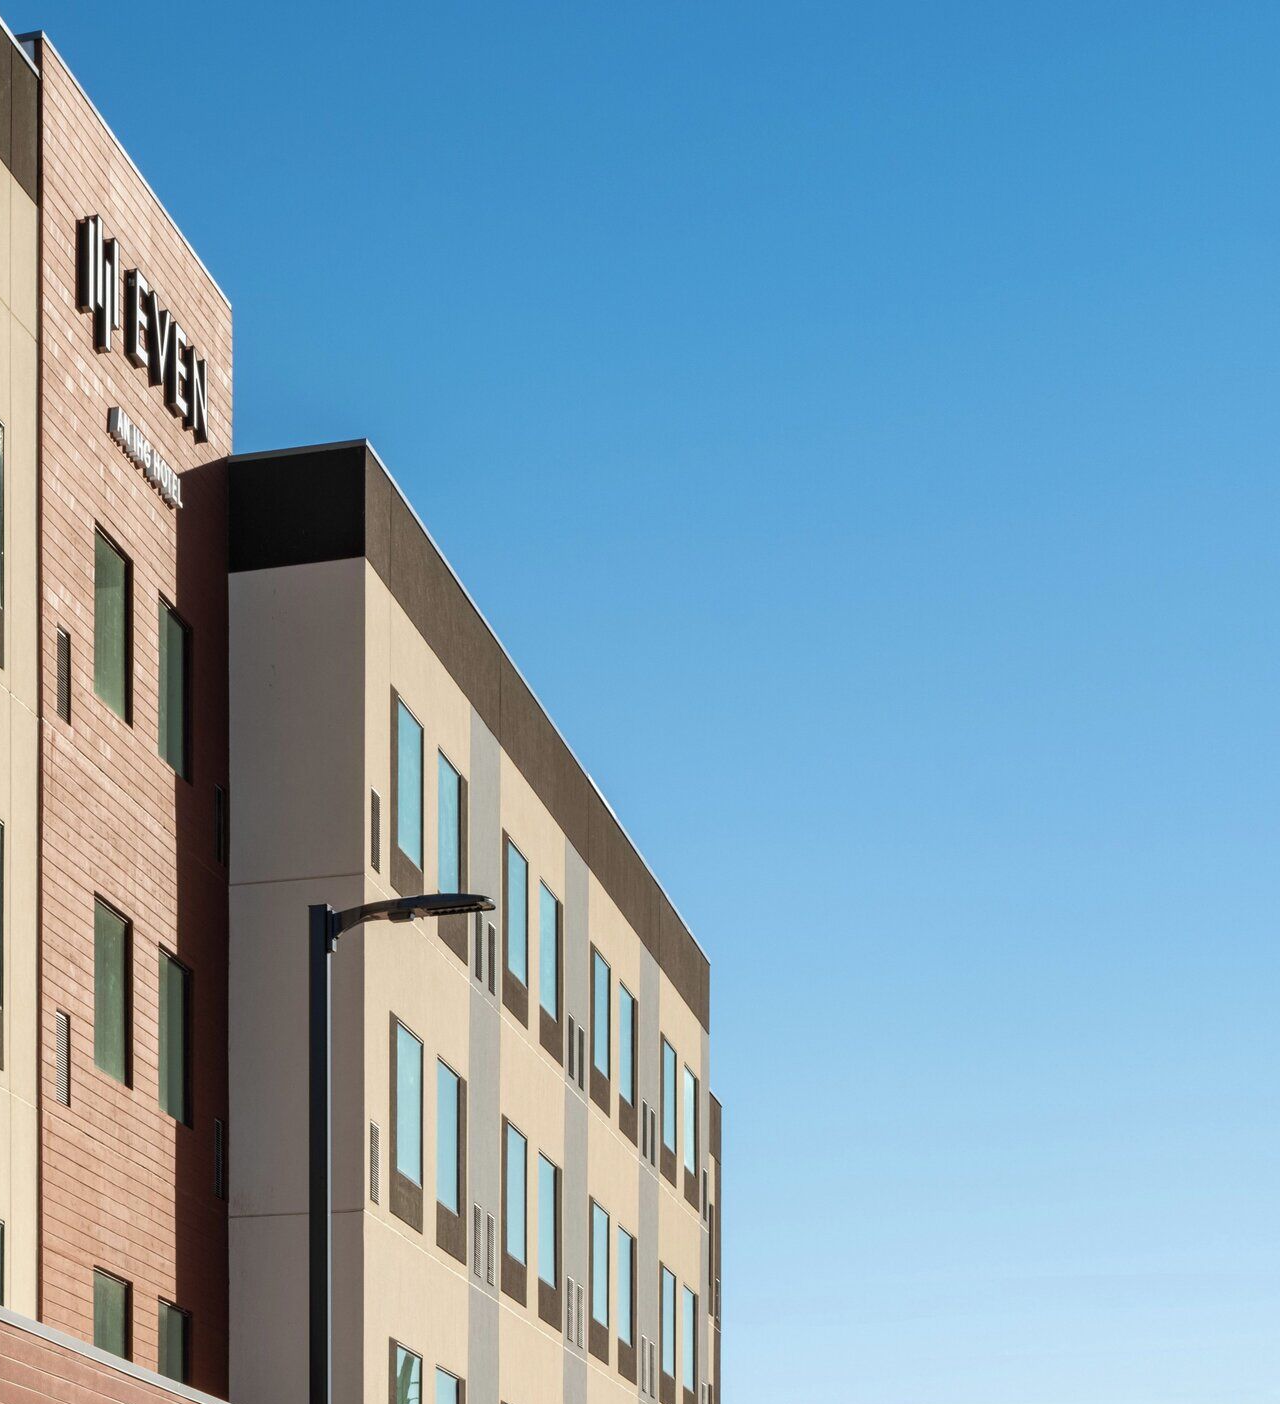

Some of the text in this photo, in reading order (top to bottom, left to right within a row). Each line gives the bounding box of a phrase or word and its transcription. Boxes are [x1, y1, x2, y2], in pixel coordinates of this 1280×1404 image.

[125, 268, 208, 444] EVEN
[111, 406, 183, 508] AN IHG HOTEL
